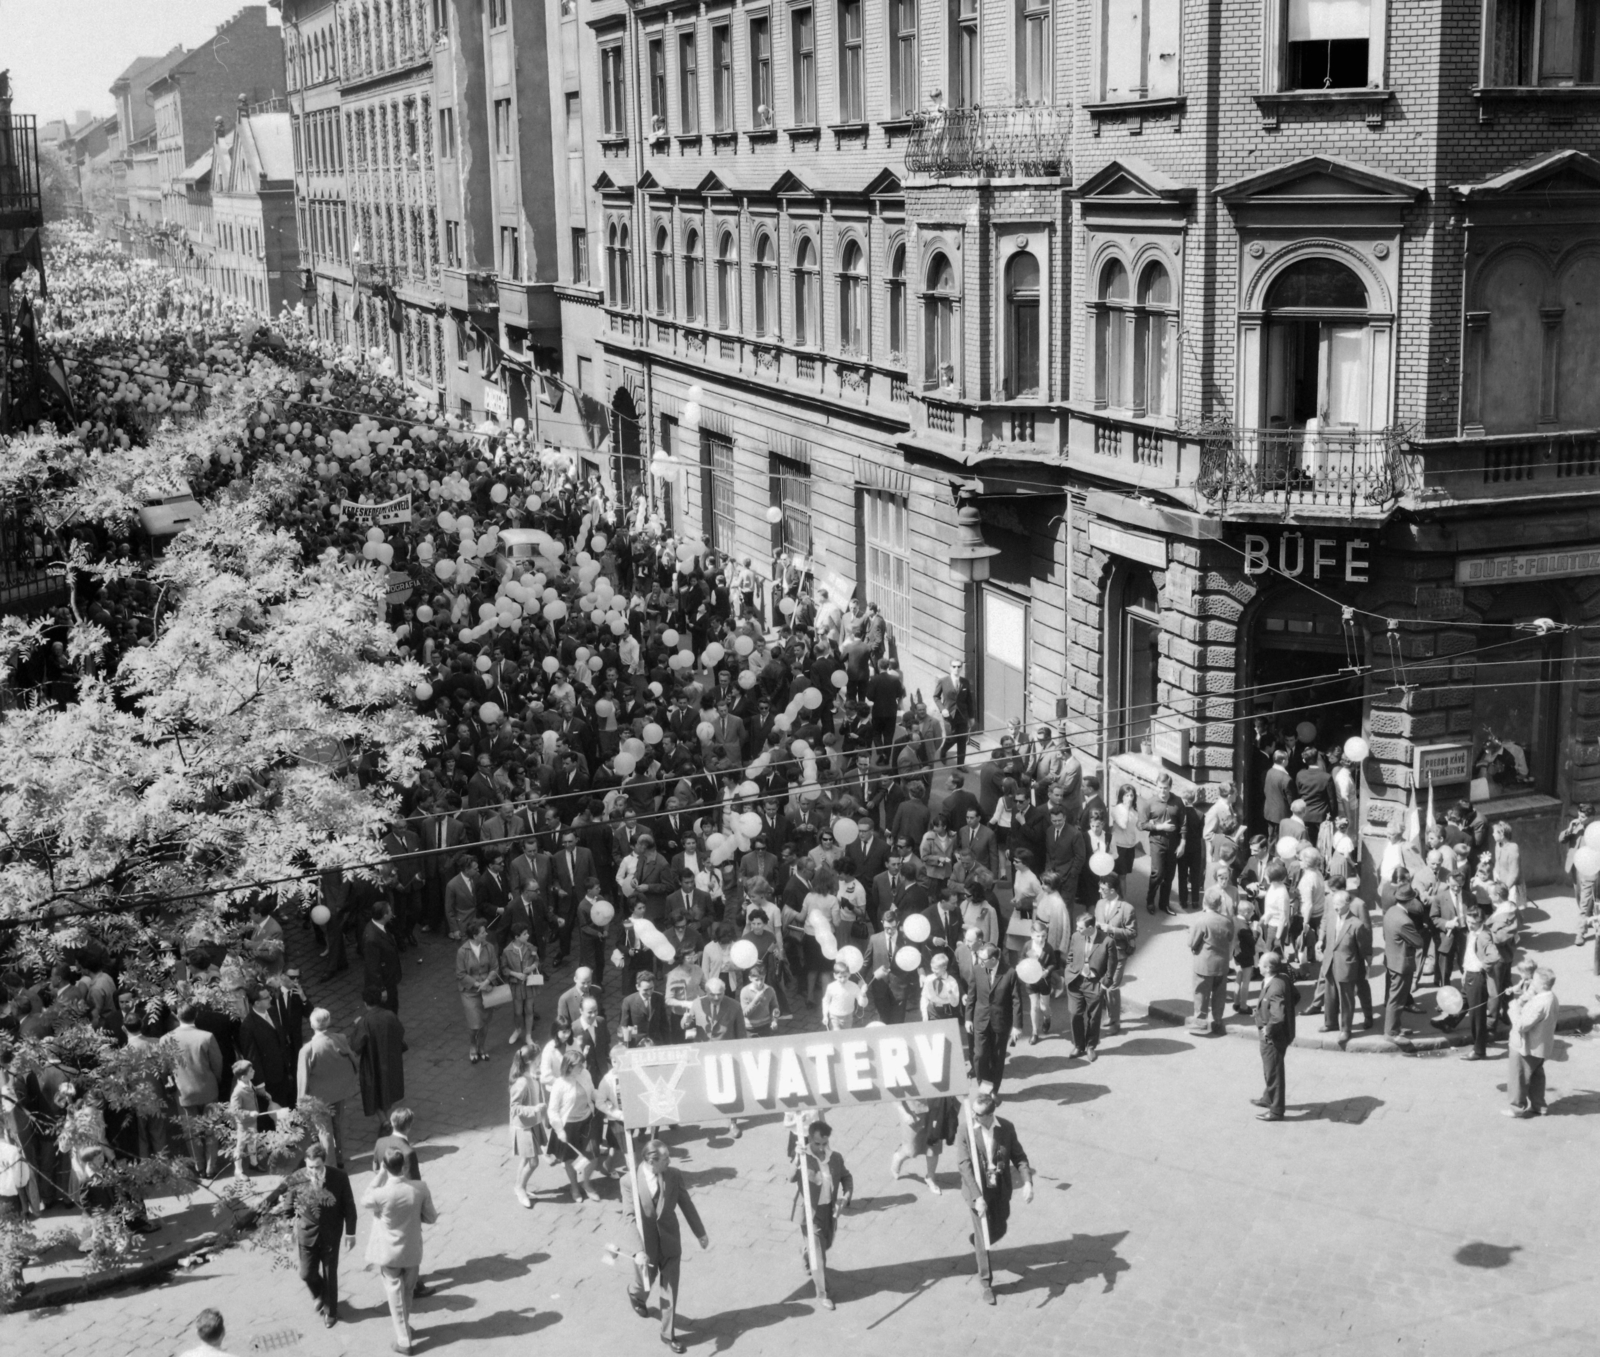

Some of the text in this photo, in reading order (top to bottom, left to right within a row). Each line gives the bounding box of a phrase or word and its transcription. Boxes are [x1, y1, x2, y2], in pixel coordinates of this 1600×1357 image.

[1244, 531, 1370, 583] BÜFÉ
[1469, 556, 1518, 579] BÜFÉ
[704, 1033, 946, 1105] UVATERV
